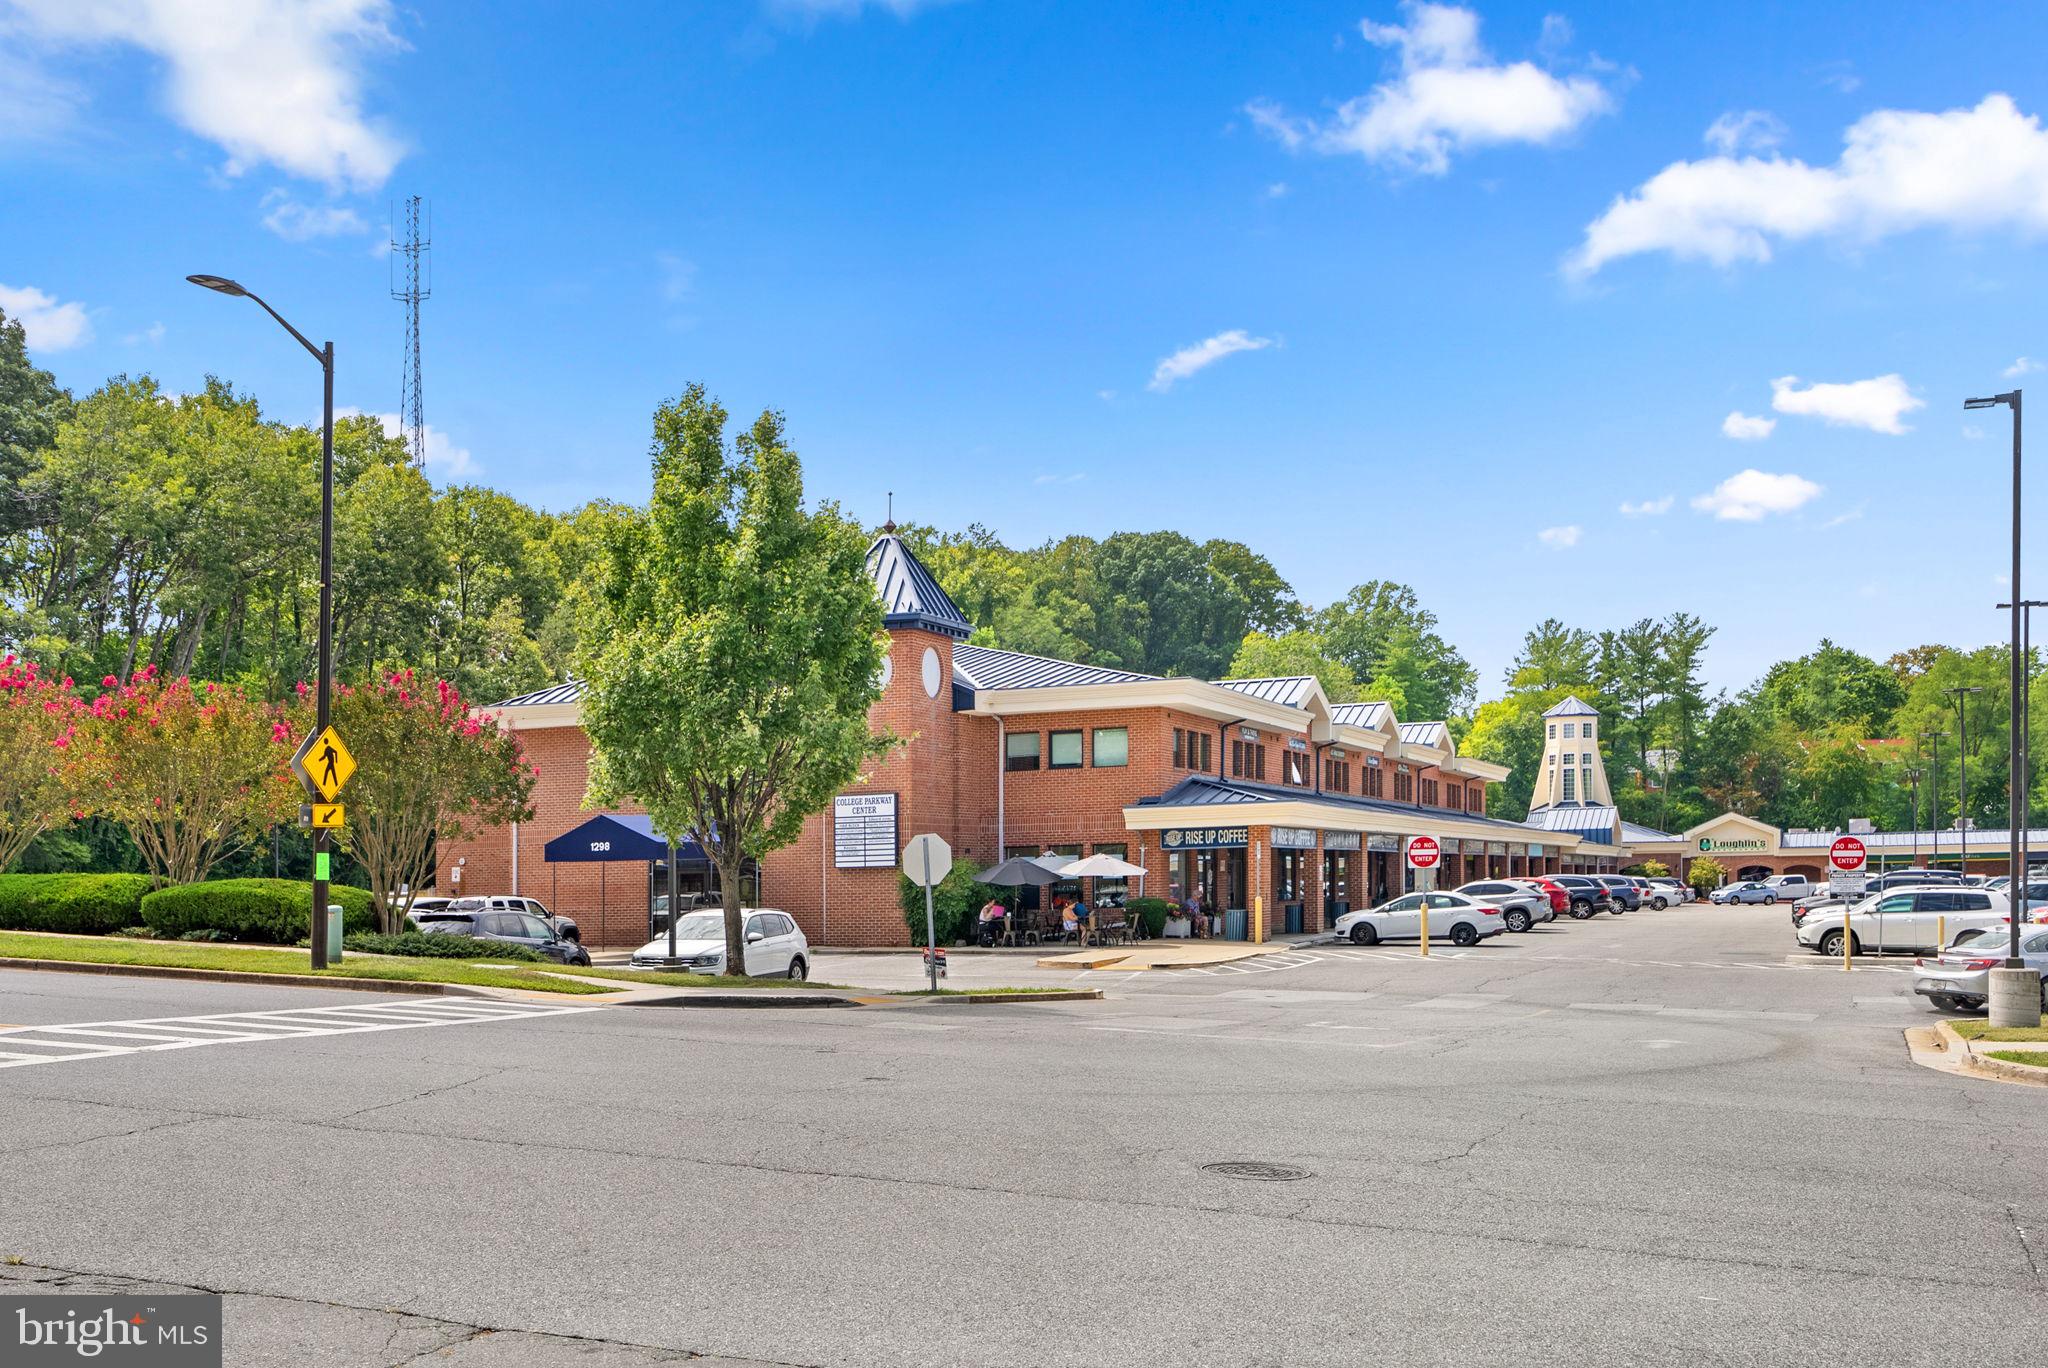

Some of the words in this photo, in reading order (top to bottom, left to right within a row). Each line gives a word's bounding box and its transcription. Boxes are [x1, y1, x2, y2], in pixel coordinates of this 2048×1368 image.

[836, 798, 863, 806] COLLEGE
[864, 796, 893, 805] PARKWAY
[852, 806, 877, 814] CENTER
[1185, 830, 1204, 845] RISE
[1205, 830, 1216, 844] UP
[1217, 829, 1248, 843] COFFEE
[590, 841, 610, 852] 1298
